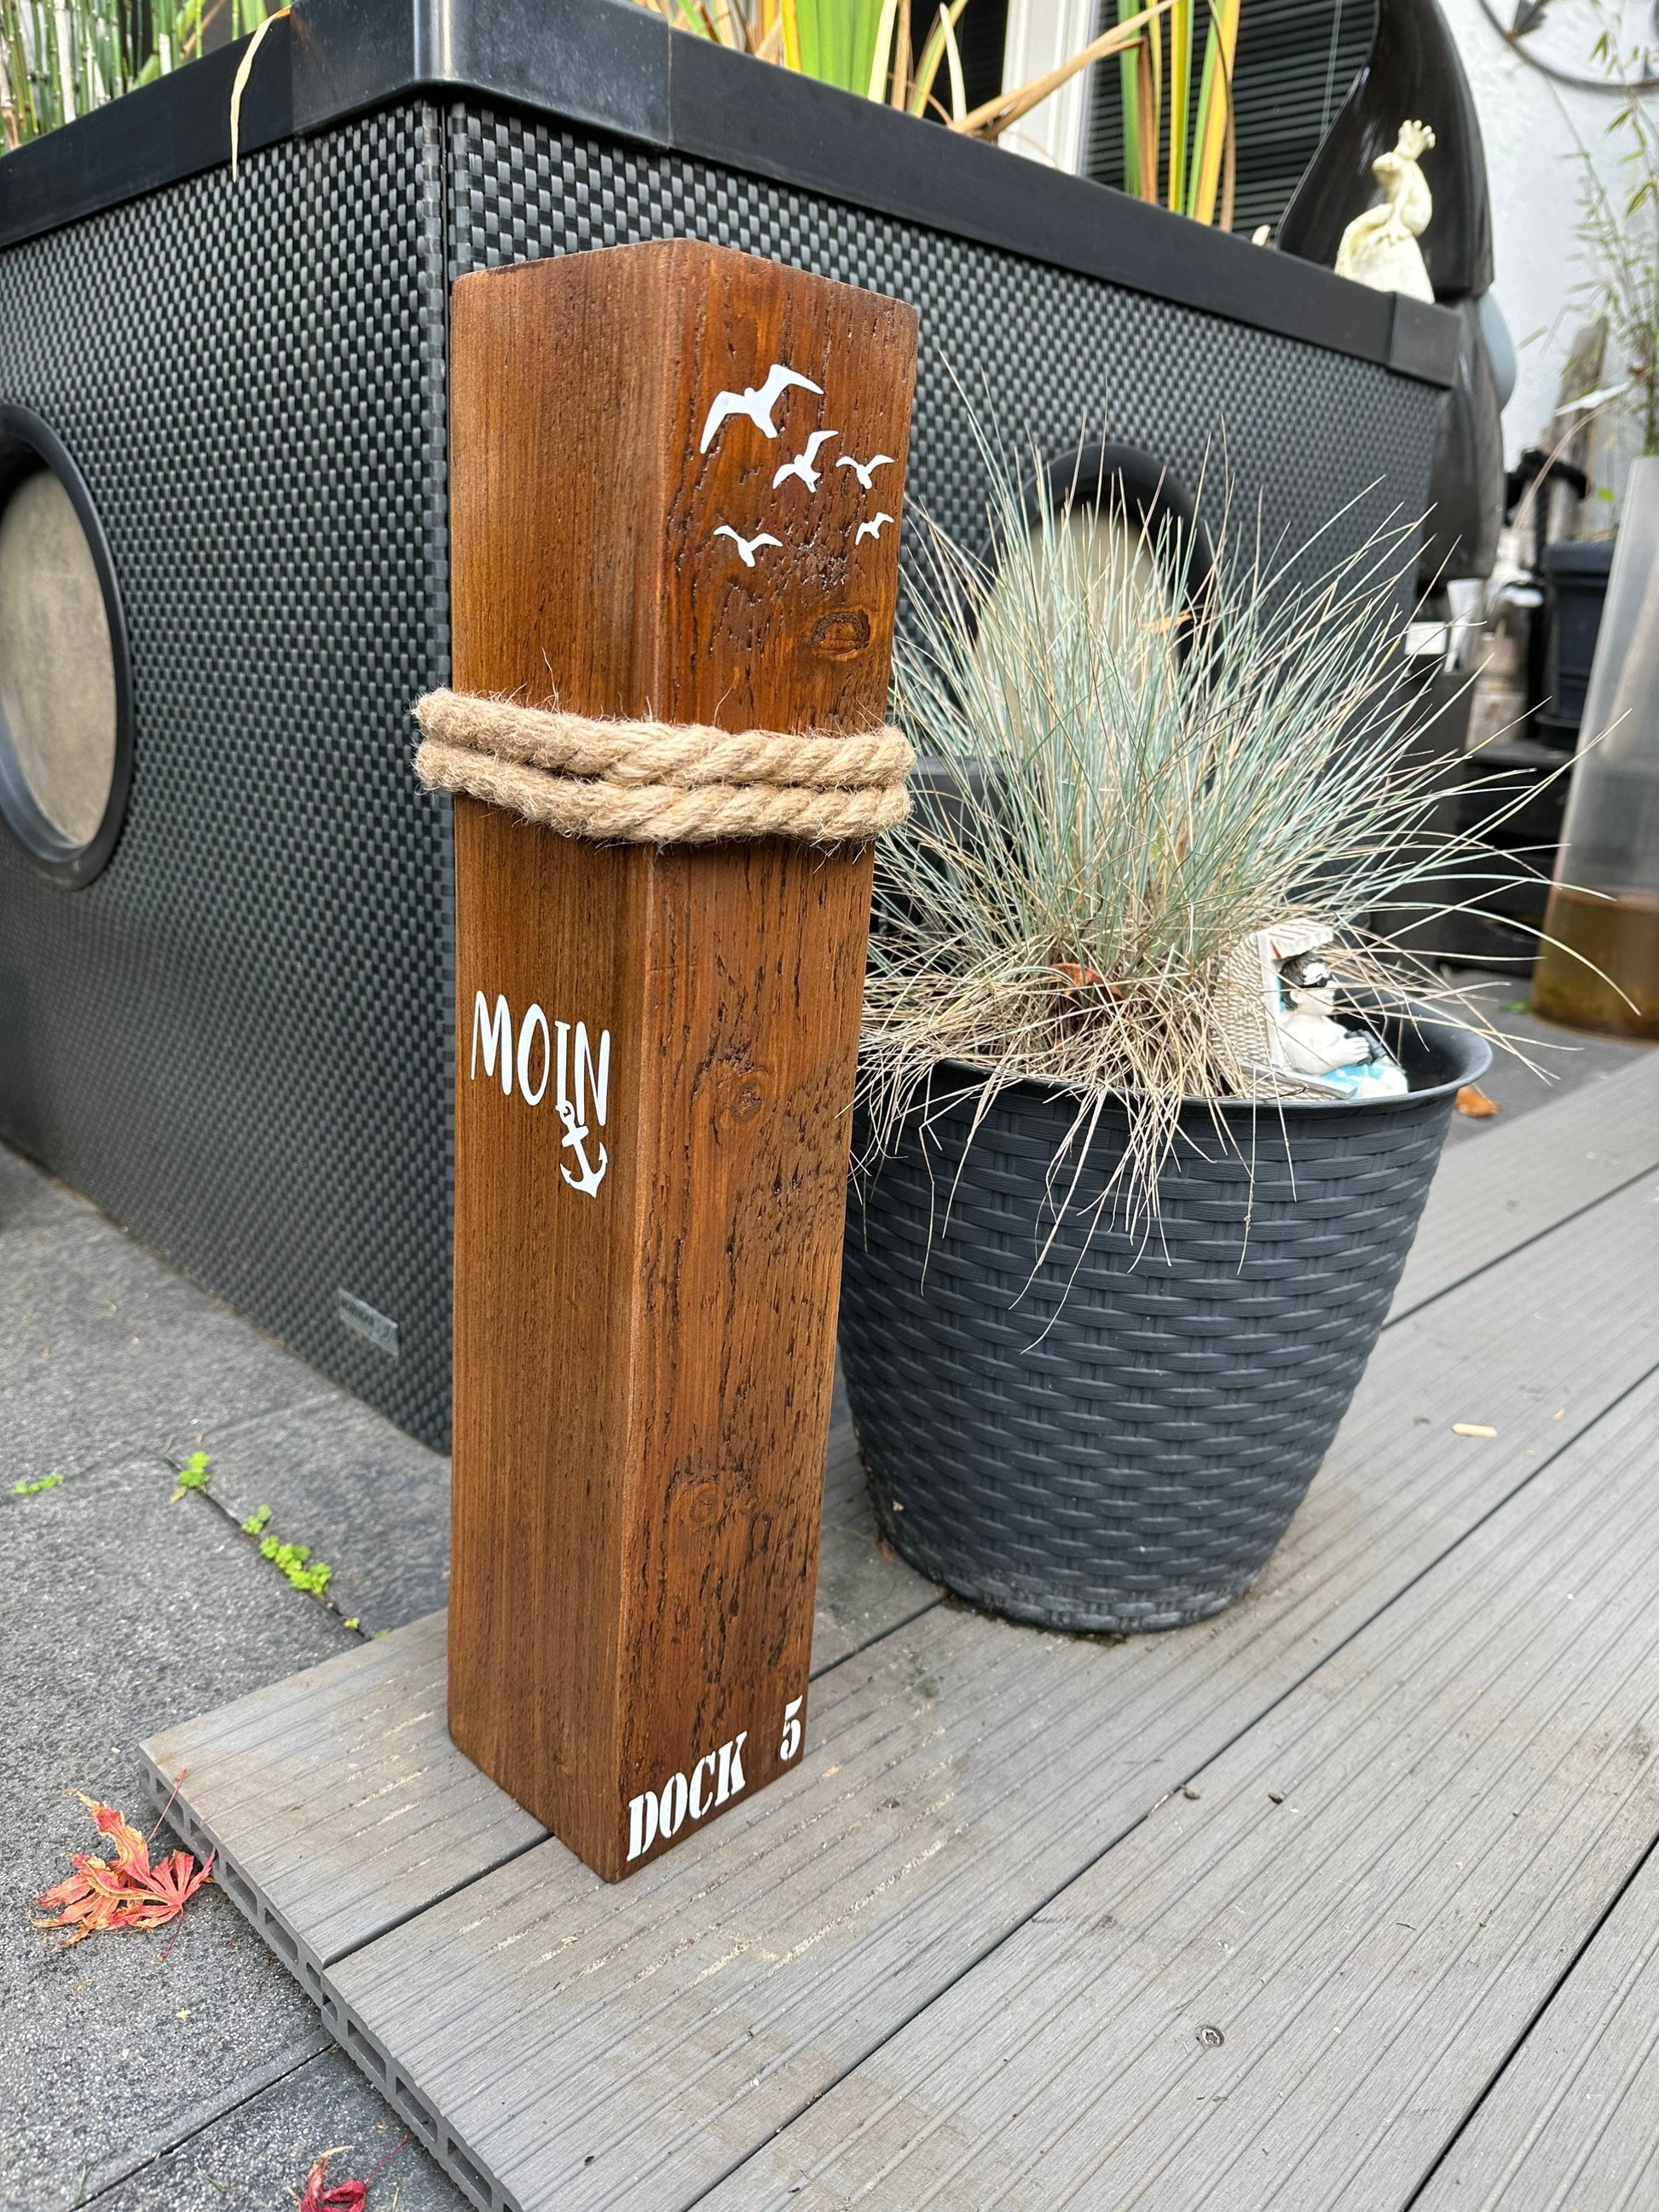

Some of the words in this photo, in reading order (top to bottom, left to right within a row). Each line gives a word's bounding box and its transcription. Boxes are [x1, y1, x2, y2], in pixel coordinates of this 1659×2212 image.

[471, 990, 610, 1127] MOIN
[627, 1730, 748, 1862] DOCK
[779, 1695, 803, 1761] 5
